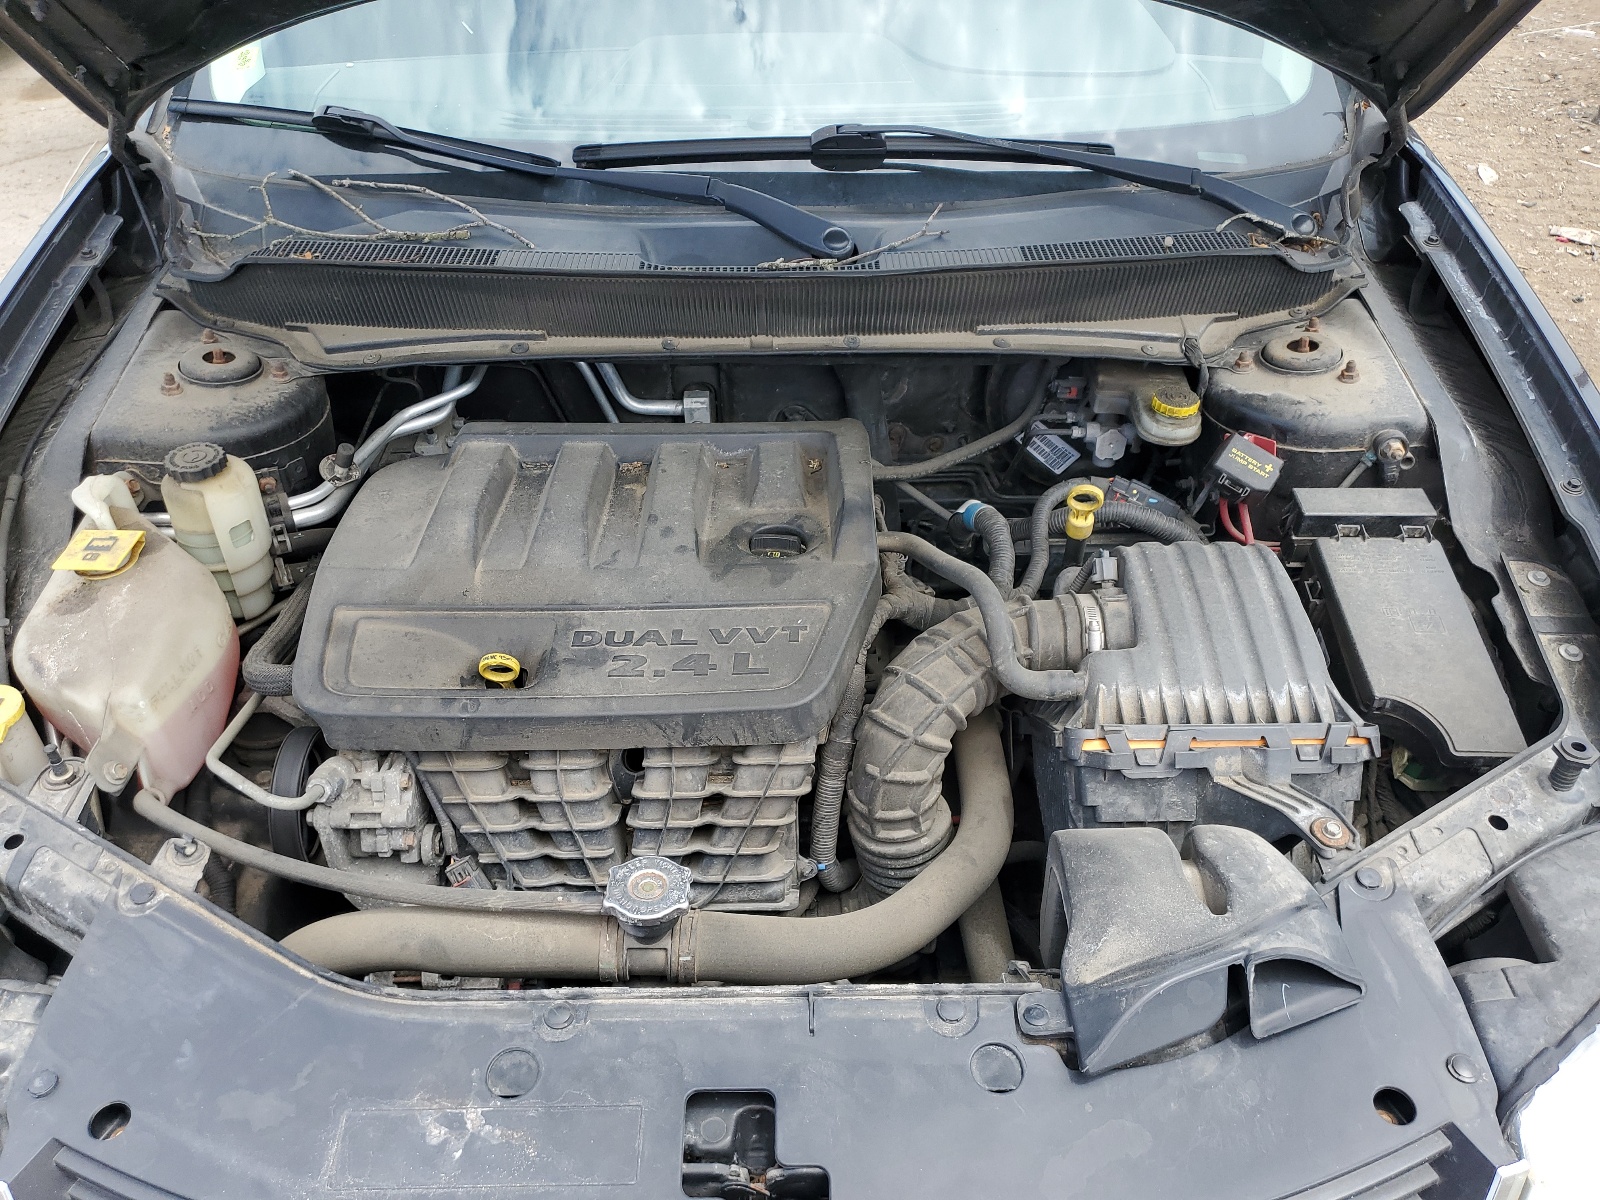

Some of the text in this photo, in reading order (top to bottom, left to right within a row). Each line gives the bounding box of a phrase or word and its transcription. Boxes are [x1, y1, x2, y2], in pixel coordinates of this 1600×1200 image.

[1228, 453, 1270, 479] JUMP START
[1231, 447, 1262, 468] BATTERY
[570, 625, 809, 648] DUAL VVT
